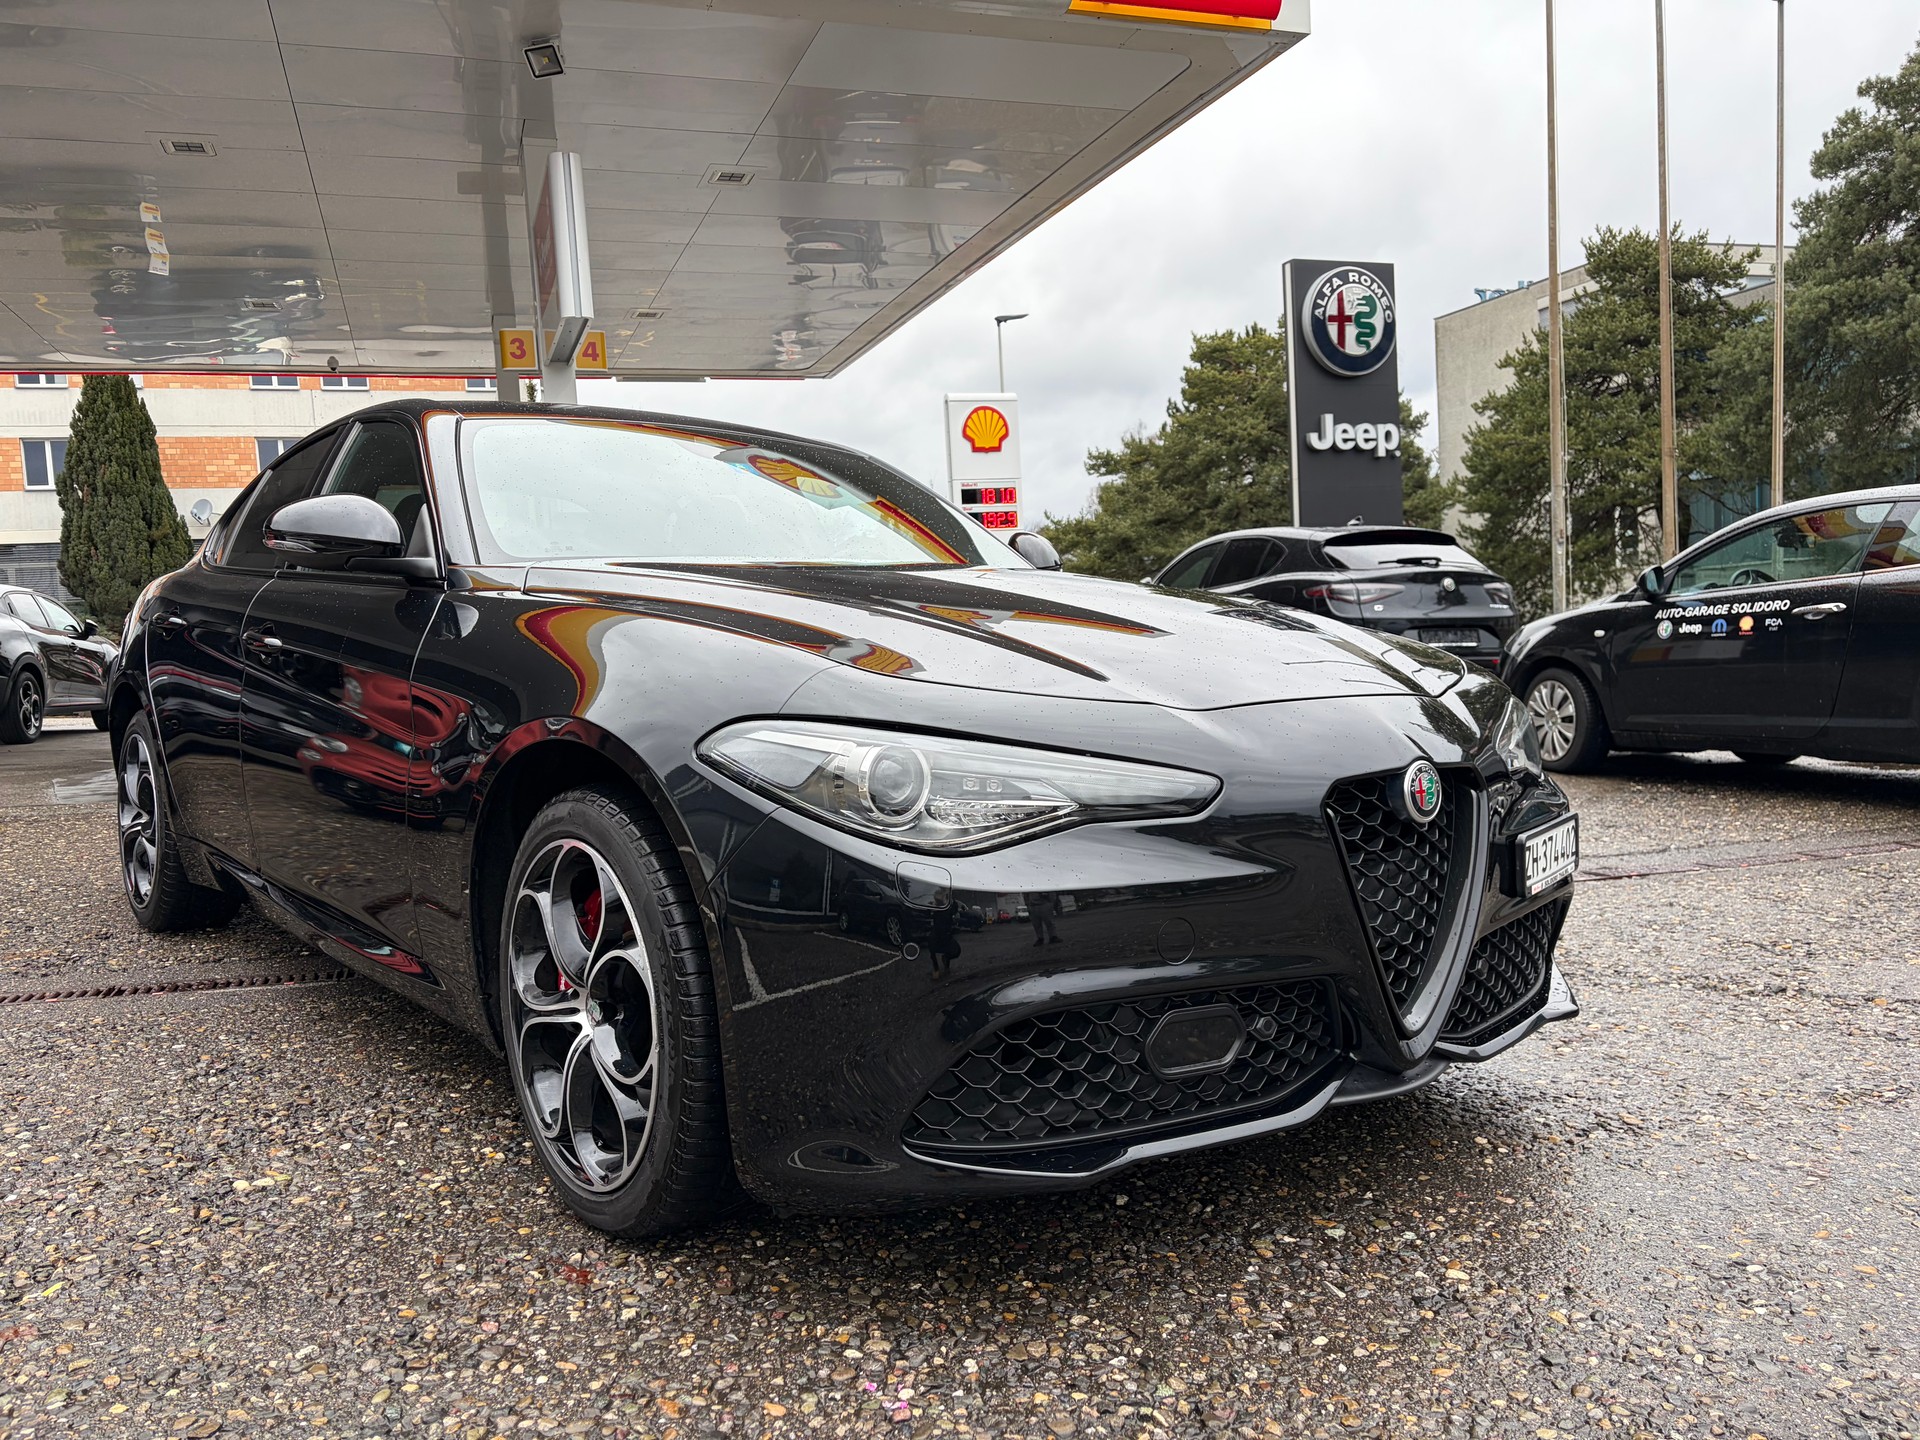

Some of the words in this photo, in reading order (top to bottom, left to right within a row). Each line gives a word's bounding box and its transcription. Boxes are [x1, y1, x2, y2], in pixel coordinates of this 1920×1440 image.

[1314, 277, 1343, 320] ALFA
[1348, 272, 1393, 324] ROMEO
[509, 337, 527, 360] 3
[582, 341, 600, 362] 4
[1306, 412, 1400, 458] Jeep
[1655, 604, 1730, 619] AUTO-GARAGE
[1731, 600, 1790, 614] SOLIDORO
[1678, 622, 1702, 635] Jeep
[1765, 618, 1783, 627] FCA
